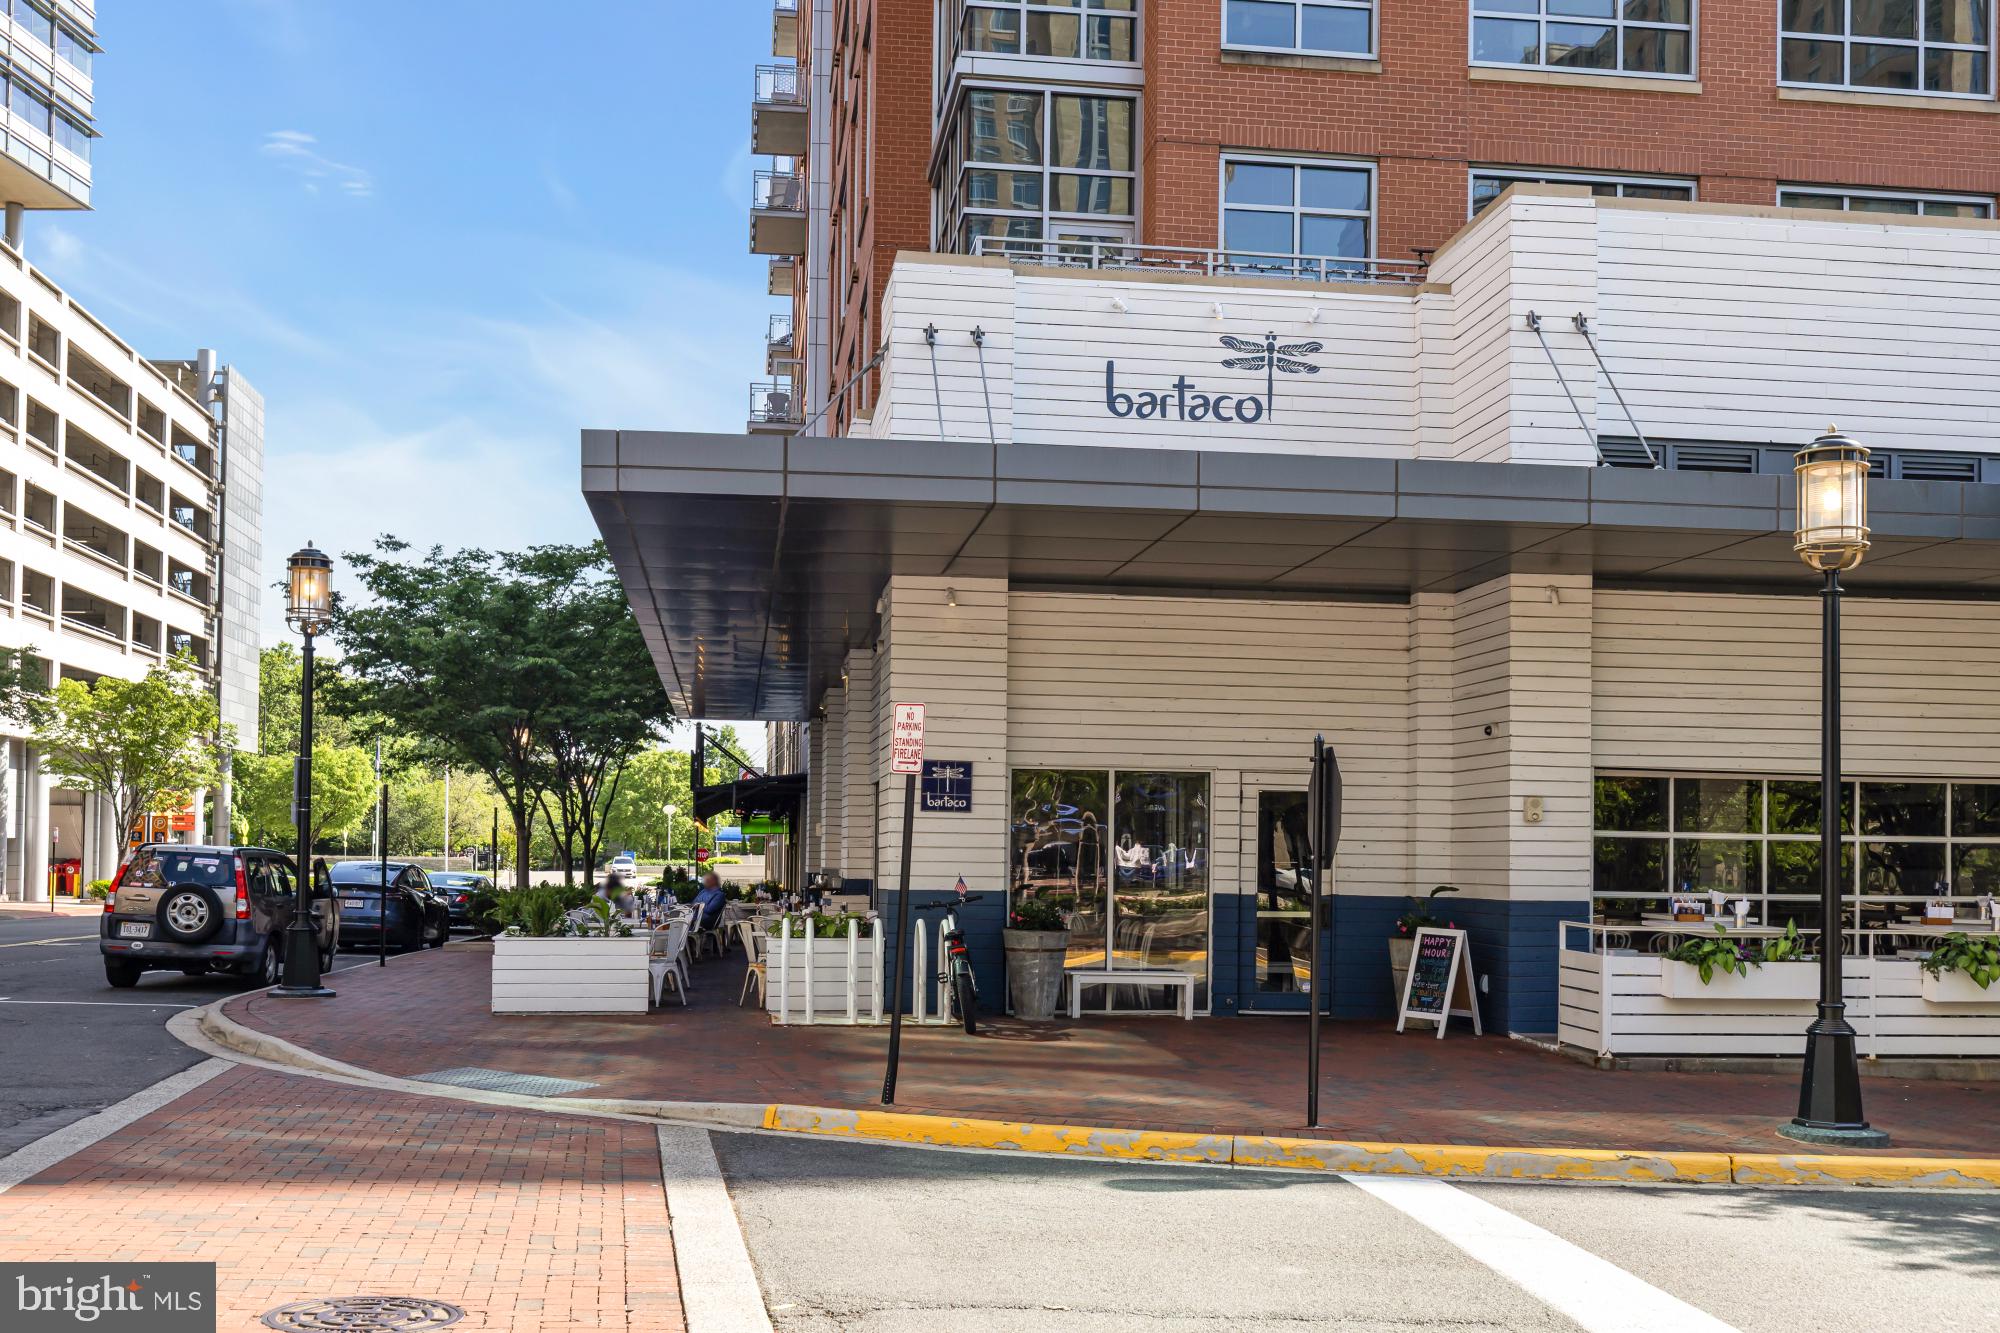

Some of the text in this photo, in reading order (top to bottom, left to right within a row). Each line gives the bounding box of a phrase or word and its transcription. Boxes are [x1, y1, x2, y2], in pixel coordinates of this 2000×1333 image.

[1106, 360, 1263, 423] bartaco
[906, 711, 915, 721] NO
[897, 722, 922, 732] PARKING
[895, 738, 922, 747] STANDING
[927, 791, 967, 808] bartaco
[1424, 936, 1453, 947] HAPPY
[1424, 948, 1447, 958] HOUR
